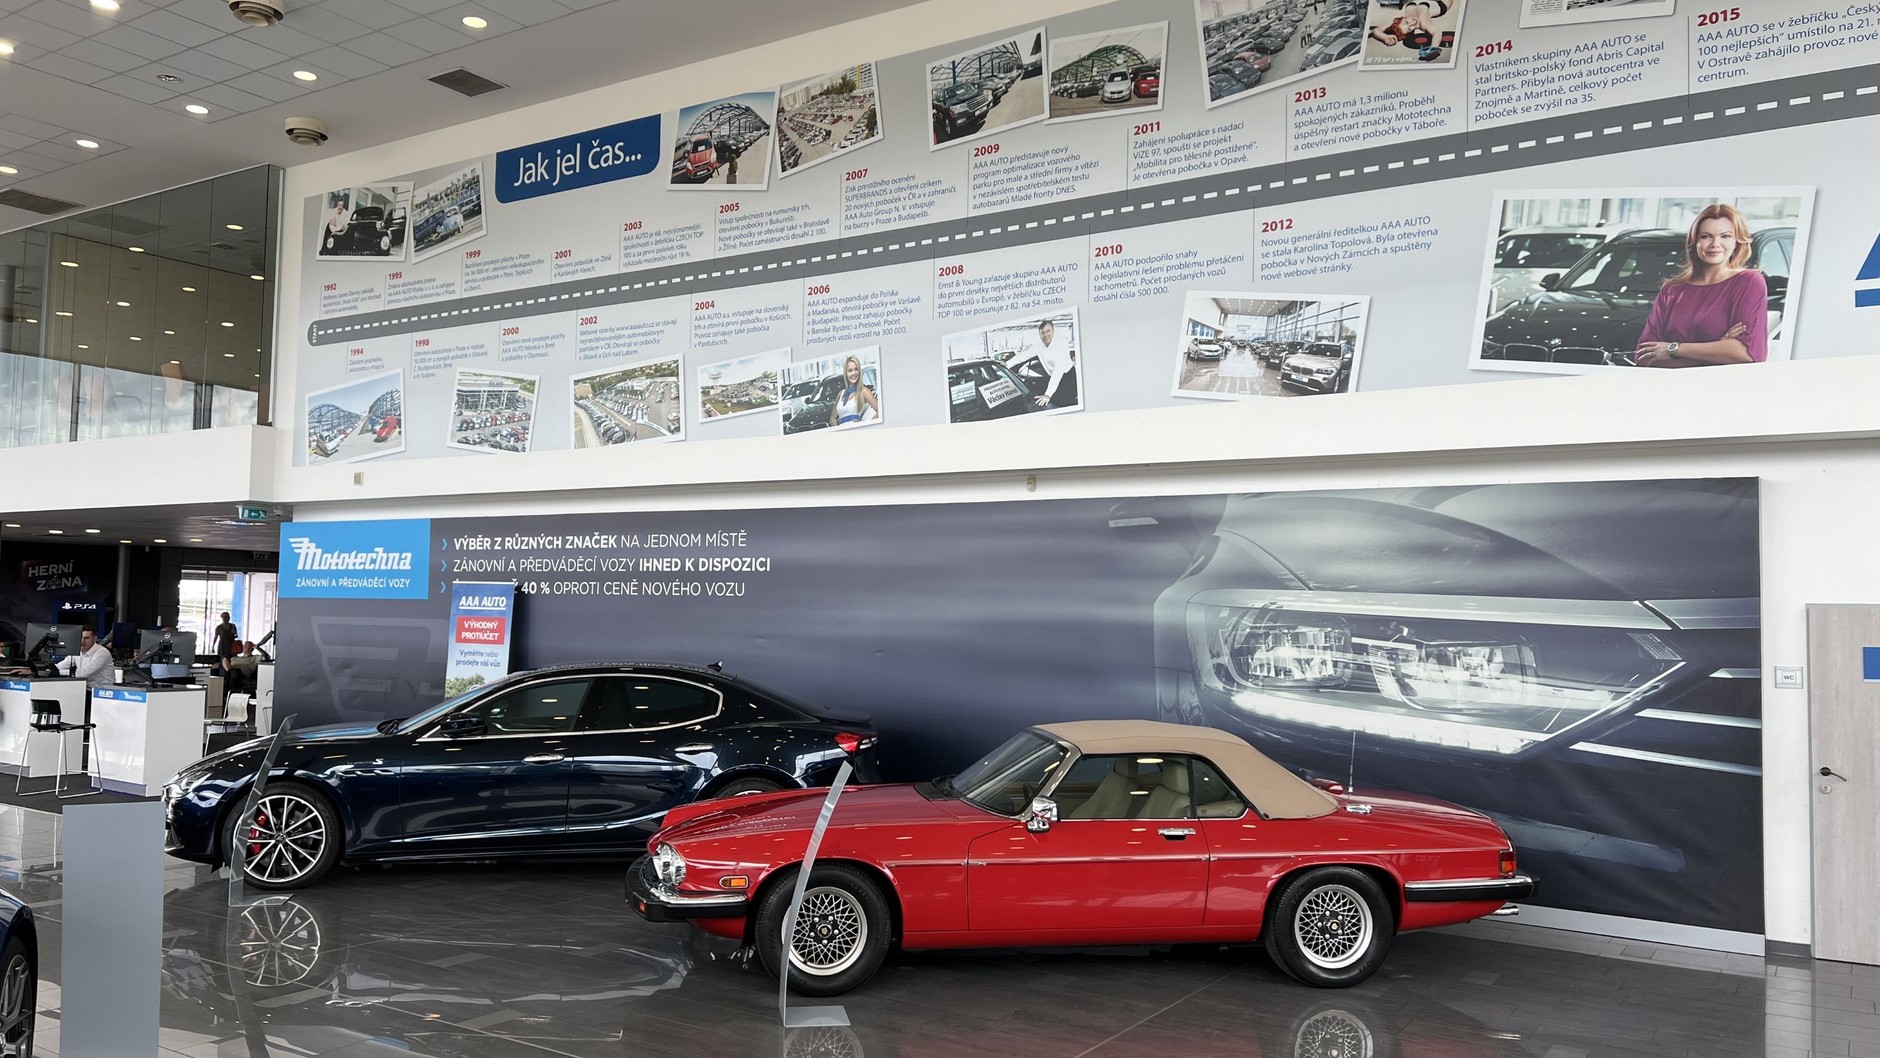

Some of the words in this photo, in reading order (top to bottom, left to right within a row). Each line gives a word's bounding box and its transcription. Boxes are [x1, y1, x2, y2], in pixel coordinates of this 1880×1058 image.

[1698, 7, 1741, 27] 2015
[1698, 30, 1723, 43] AAA
[1726, 23, 1760, 38] AUTO
[1763, 23, 1775, 32] se
[1788, 10, 1839, 27] žebříčku
[1699, 44, 1718, 56] 100
[1788, 24, 1836, 41] umístilo
[1839, 23, 1854, 32] na
[1858, 18, 1873, 29] 21.
[1475, 56, 1530, 73] Vlastníkem
[1532, 48, 1572, 62] skupiny
[1574, 42, 1598, 54] AAA
[1601, 35, 1632, 49] AUTO
[1635, 34, 1646, 43] se
[1476, 40, 1513, 58] 2014
[1698, 60, 1705, 70] V
[1708, 51, 1752, 68] Ostravě
[1755, 44, 1800, 60] zahájilo
[1804, 38, 1845, 54] provoz
[1849, 30, 1879, 44] nové
[1475, 73, 1492, 85] stal
[1495, 60, 1566, 82] britsko-polský
[1569, 54, 1594, 68] fond
[1596, 50, 1624, 62] Abris
[1626, 41, 1664, 57] Capital
[1475, 84, 1518, 98] Partners.
[1521, 75, 1555, 89] Přibyla
[1558, 69, 1584, 82] nová
[1586, 60, 1644, 77] autocentra
[1647, 57, 1660, 66] ve
[1698, 68, 1750, 83] centrum.
[1294, 106, 1314, 117] AAA
[1316, 101, 1341, 113] AUTO
[1343, 98, 1357, 108] má
[1360, 96, 1372, 106] 1,3
[1374, 90, 1409, 103] milionu
[1296, 87, 1327, 103] 2013
[1295, 111, 1348, 130] spokojených
[1350, 103, 1397, 119] zákazníků.
[1399, 95, 1435, 110] Proběhl
[1134, 120, 1160, 137] 2011
[1294, 126, 1329, 141] úspěšný
[1331, 122, 1360, 134] restart
[1362, 116, 1393, 128] značky
[1395, 106, 1452, 122] Mototechna
[1134, 136, 1166, 150] Zahájení
[1168, 129, 1210, 145] spolupráce
[1218, 121, 1244, 134] nadací
[973, 160, 988, 170] AAA
[990, 156, 1009, 167] AUTO
[1010, 149, 1050, 165] představuje
[1051, 145, 1069, 156] nový
[974, 143, 1002, 158] 2009
[514, 152, 549, 186] Jak
[553, 143, 580, 186] jel
[588, 139, 641, 169] čas...
[973, 170, 1002, 182] program
[1003, 161, 1045, 176] optimalizace
[1047, 153, 1081, 166] vozového
[845, 167, 868, 182] 2007
[719, 201, 740, 215] 2005
[624, 220, 642, 232] 2003
[1261, 238, 1290, 247] Novou
[1291, 229, 1332, 245] generální
[1334, 224, 1379, 237] ředitelkou
[1381, 220, 1401, 230] AAA
[1404, 216, 1431, 227] AUTO
[1263, 217, 1294, 234] 2012
[1095, 243, 1124, 257] 2010
[1272, 247, 1292, 257] stala
[1293, 243, 1329, 254] Karolína
[1332, 236, 1374, 250] Topolová.
[1376, 233, 1395, 244] Byla
[1397, 229, 1439, 240] otevřena
[466, 249, 480, 259] 1999
[555, 249, 570, 259] 2001
[1094, 262, 1111, 271] AAA
[1112, 258, 1135, 268] AUTO
[1136, 253, 1174, 267] podpořilo
[1175, 249, 1198, 260] snahy
[938, 264, 964, 278] 2008
[1041, 267, 1056, 275] AAA
[1058, 264, 1078, 273] AUTO
[808, 285, 830, 296] 2006
[695, 300, 716, 311] 2004
[581, 316, 598, 326] 2002
[503, 326, 520, 336] 2000
[416, 338, 430, 347] 1998
[454, 535, 491, 550] VÝBĚR
[494, 538, 501, 550] Z
[505, 533, 561, 550] RŮZNÝCH
[565, 532, 617, 549] ZNAČEK
[621, 535, 640, 548] NA
[644, 533, 701, 548] JEDNOM
[706, 530, 747, 547] MÍSTĚ
[288, 538, 412, 570] Mototechna
[28, 560, 74, 577] HERNÍ
[453, 557, 505, 572] ZÁNOVNÍ
[508, 560, 516, 572] A
[520, 556, 597, 572] PŘEDVÁDĚCÍ
[600, 558, 635, 572] VOZY
[640, 558, 681, 572] IHNED
[685, 558, 694, 572] K
[699, 557, 771, 572] DISPOZICI
[296, 577, 329, 587] ZÁNOVNÍ
[331, 579, 336, 587] A
[339, 577, 386, 588] PŘEDVÁDĚCÍ
[389, 579, 410, 588] VOZY
[521, 581, 537, 594] 40
[540, 582, 550, 594] %
[554, 582, 599, 595] OPROTI
[604, 579, 638, 595] CENĚ
[642, 579, 701, 596] NOVÉHO
[705, 582, 745, 596] VOZU
[459, 596, 479, 606] AAA
[481, 596, 506, 607] AUTO
[464, 619, 498, 630] VÝHODNÝ
[462, 631, 499, 640] PROTIÚČET
